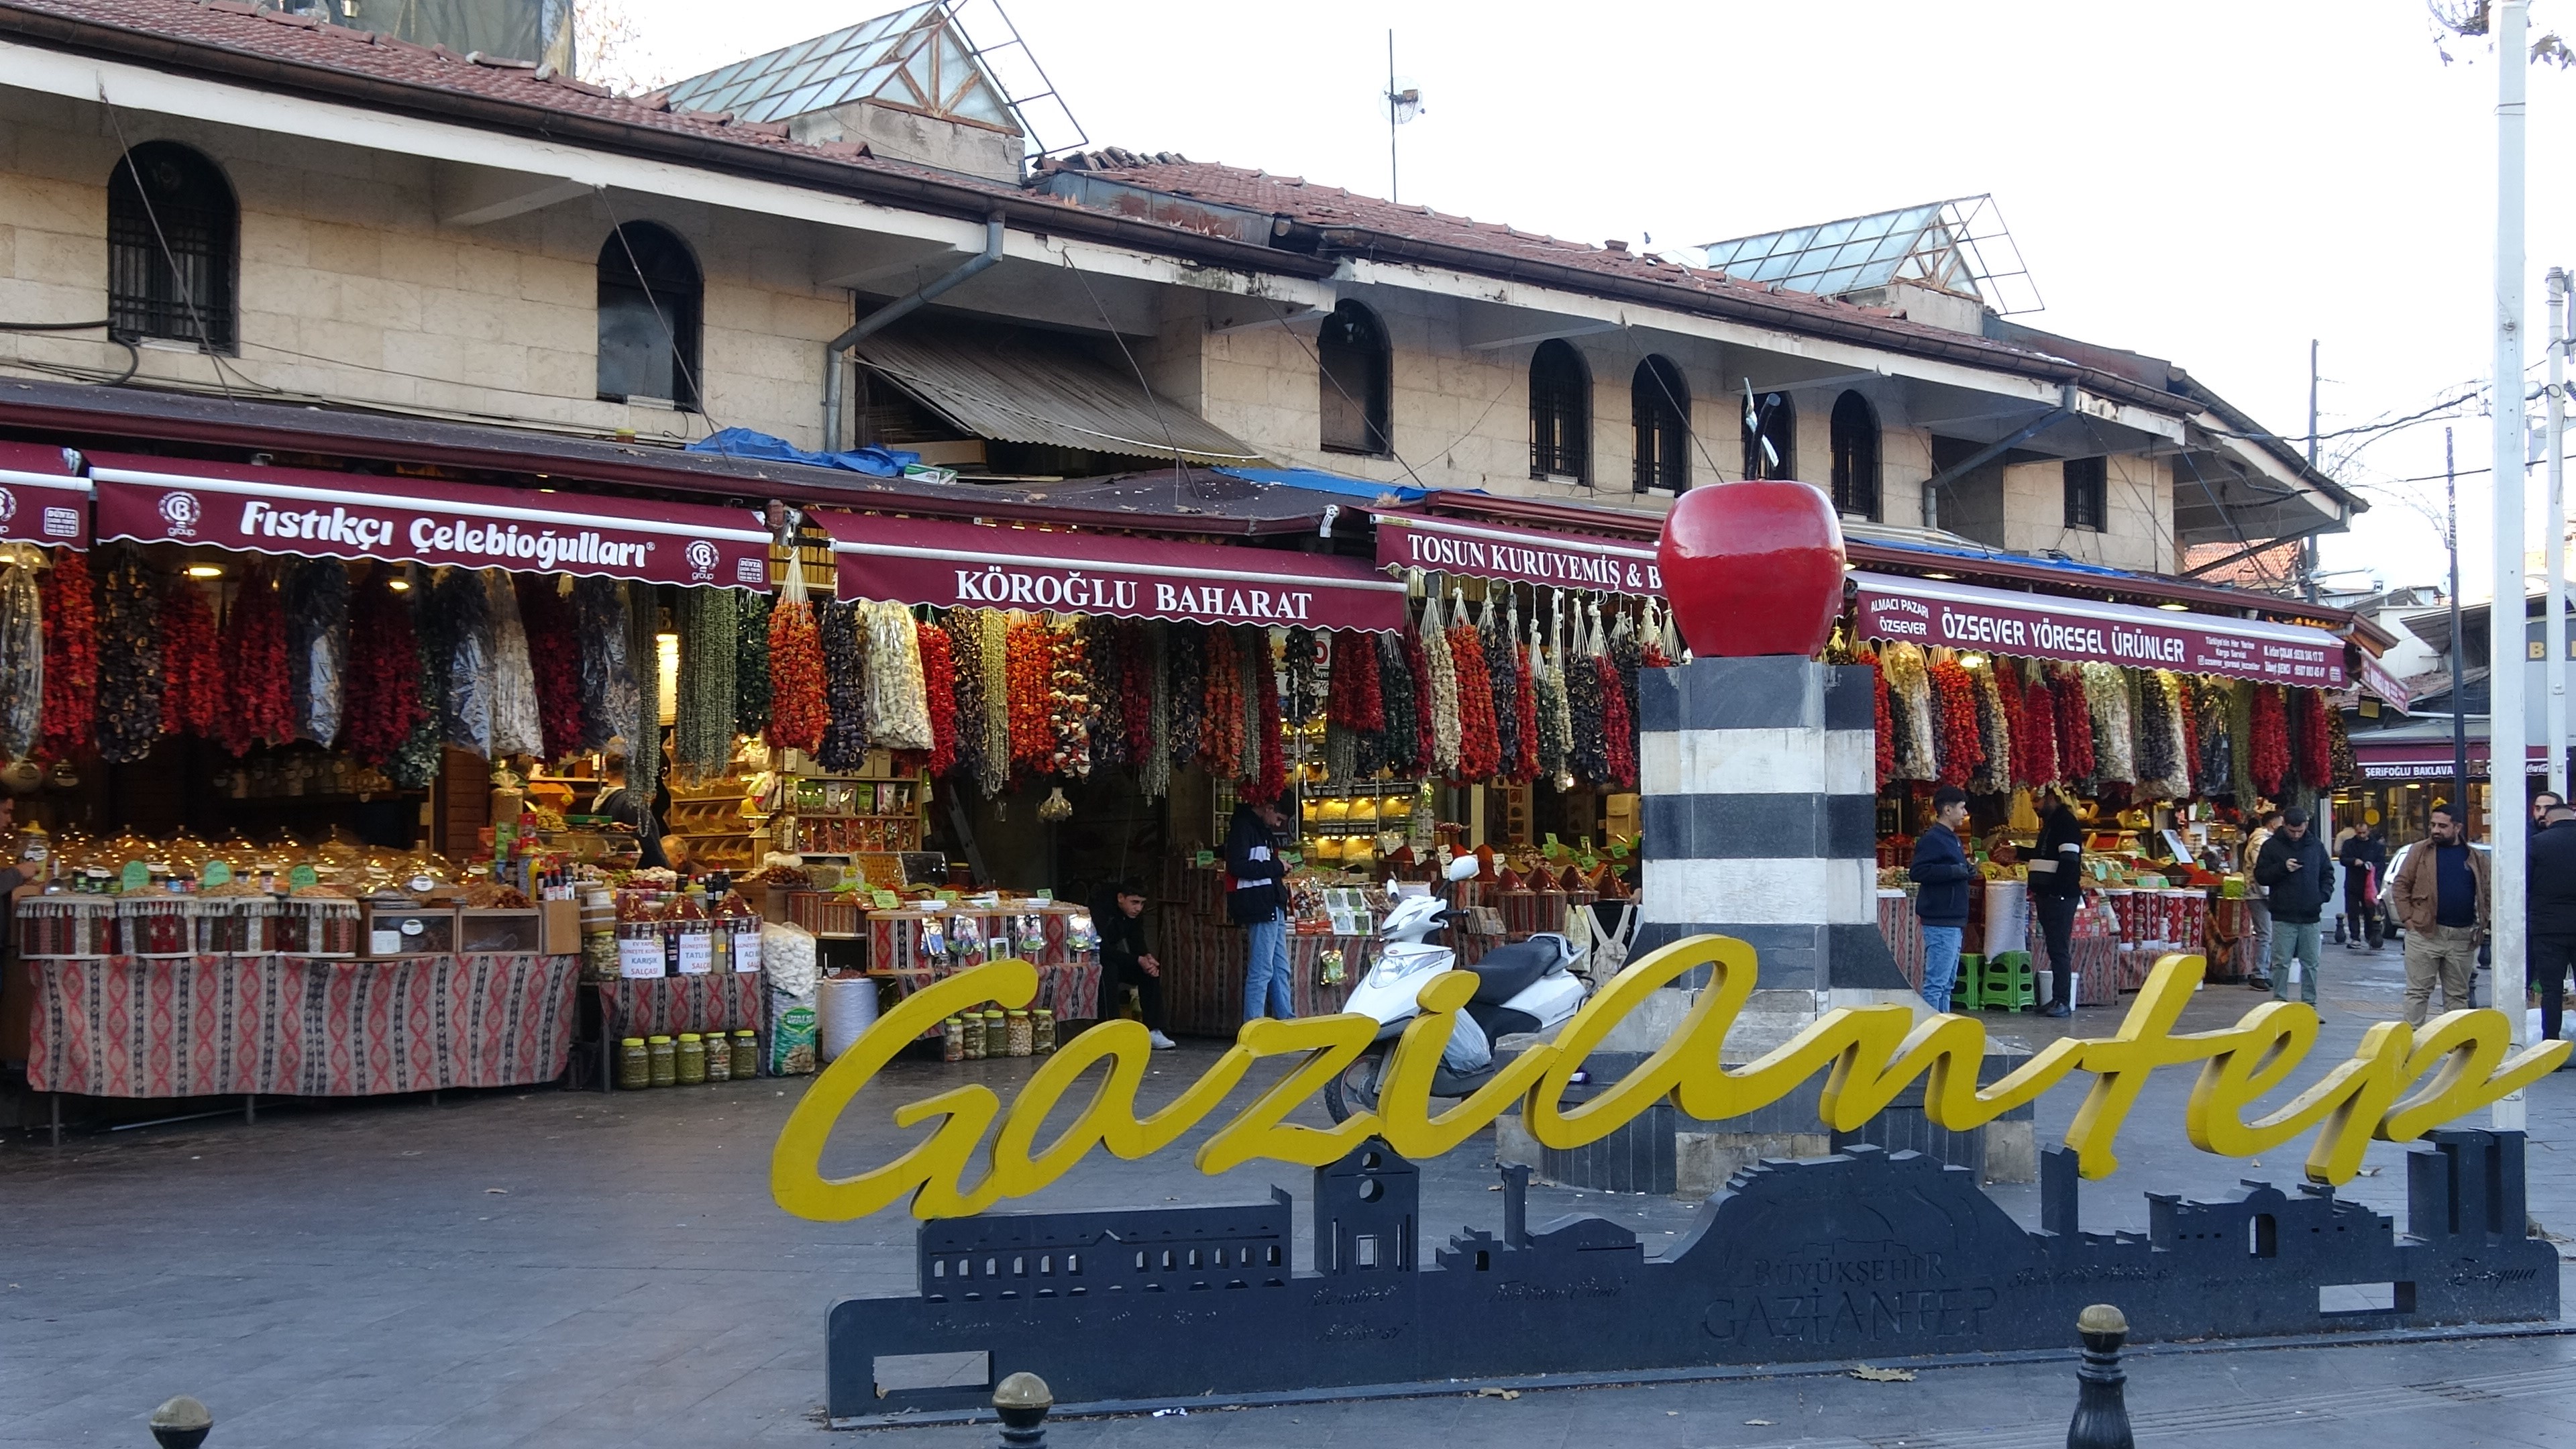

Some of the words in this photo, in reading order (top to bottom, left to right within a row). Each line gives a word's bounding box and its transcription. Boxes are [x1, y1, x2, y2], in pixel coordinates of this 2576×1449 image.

[240, 501, 394, 551] Fıstıkçı
[409, 517, 646, 570] Çelebioğulları
[1407, 534, 1487, 569] TOSUN
[1490, 544, 1621, 590] KURUYEMİŞ
[1626, 565, 1642, 588] &
[692, 572, 714, 581] group
[955, 566, 1138, 610] KÖROĞLU
[1155, 583, 1312, 620] BAHARAT
[1871, 598, 1899, 613] ALMACI
[1901, 599, 1929, 619] PAZARI
[1880, 616, 1927, 636] ÖZSEVER
[1941, 606, 2027, 646] ÖZSEVER
[2030, 617, 2108, 655] YÖRESEL
[2111, 625, 2186, 663] ÜRÜNLER
[2365, 765, 2411, 778] ŞERİFOĞLU
[2413, 765, 2454, 776] BAKLAVA
[631, 957, 657, 965] KARIŞIK
[631, 968, 658, 976] SALÇASI
